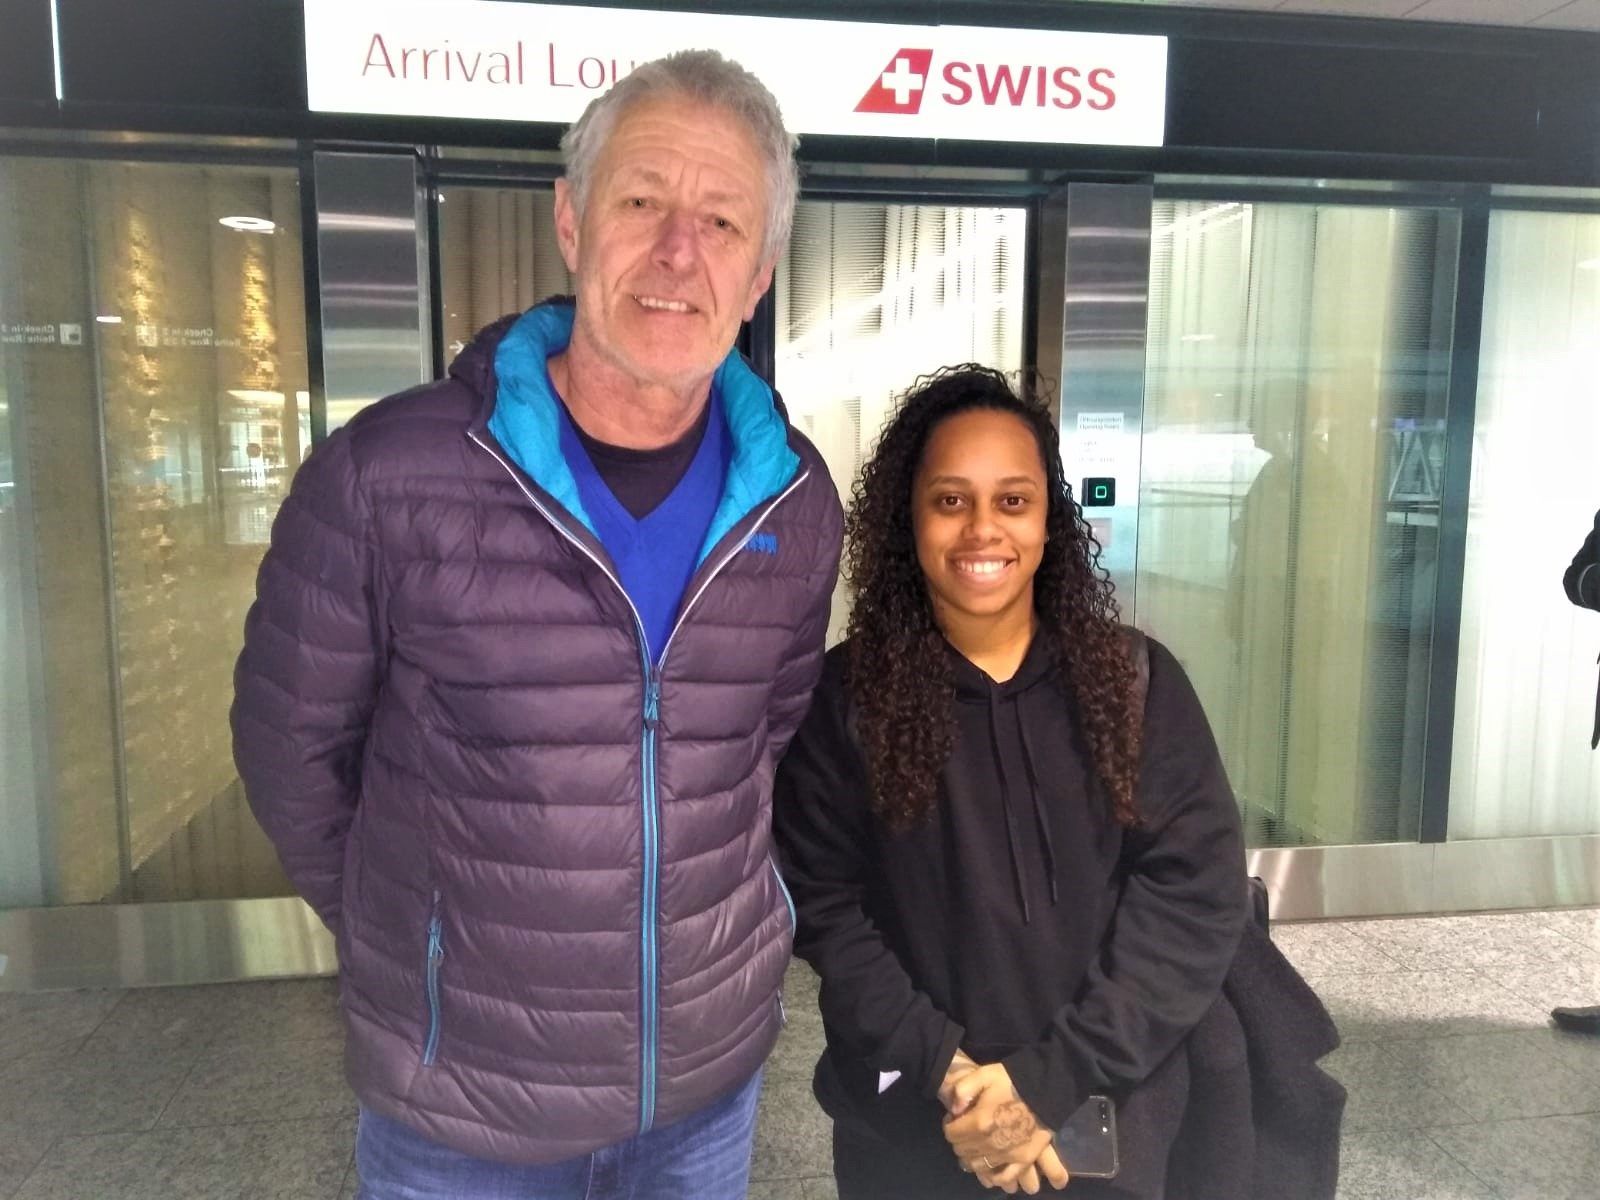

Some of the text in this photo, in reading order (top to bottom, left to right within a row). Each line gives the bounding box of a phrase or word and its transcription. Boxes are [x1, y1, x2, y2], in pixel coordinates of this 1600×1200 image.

[362, 33, 636, 90] Arrival Lou
[941, 61, 1116, 111] SWISS
